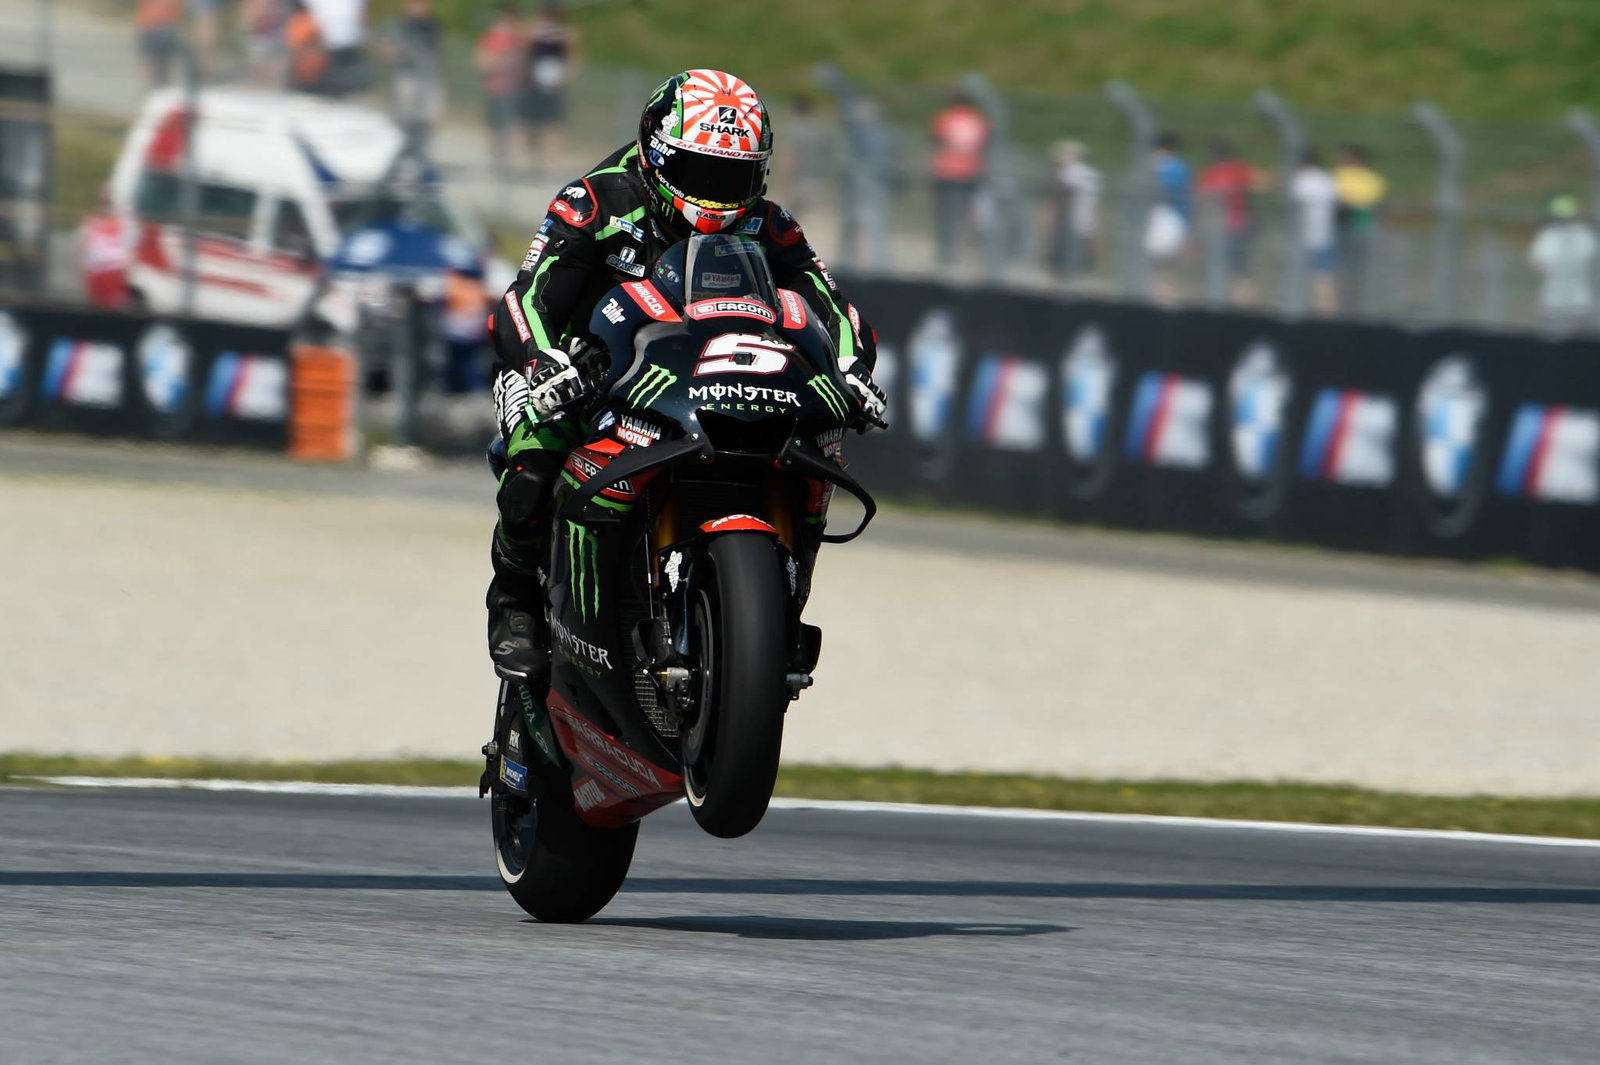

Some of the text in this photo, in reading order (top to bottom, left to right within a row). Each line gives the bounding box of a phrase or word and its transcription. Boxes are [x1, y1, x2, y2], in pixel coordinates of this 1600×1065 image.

[699, 122, 751, 138] SHARK
[650, 135, 676, 157] Bihr
[697, 146, 742, 158] GRAND
[630, 281, 666, 317] BARRACUDA
[717, 302, 771, 318] FACOM
[601, 298, 626, 325] Bihr
[693, 333, 796, 377] 5
[688, 383, 801, 407] MONSTER
[706, 403, 787, 414] ENERGY
[616, 427, 652, 448] MOTUL
[621, 413, 662, 441] YAMAHA
[550, 611, 613, 670] MONSTER
